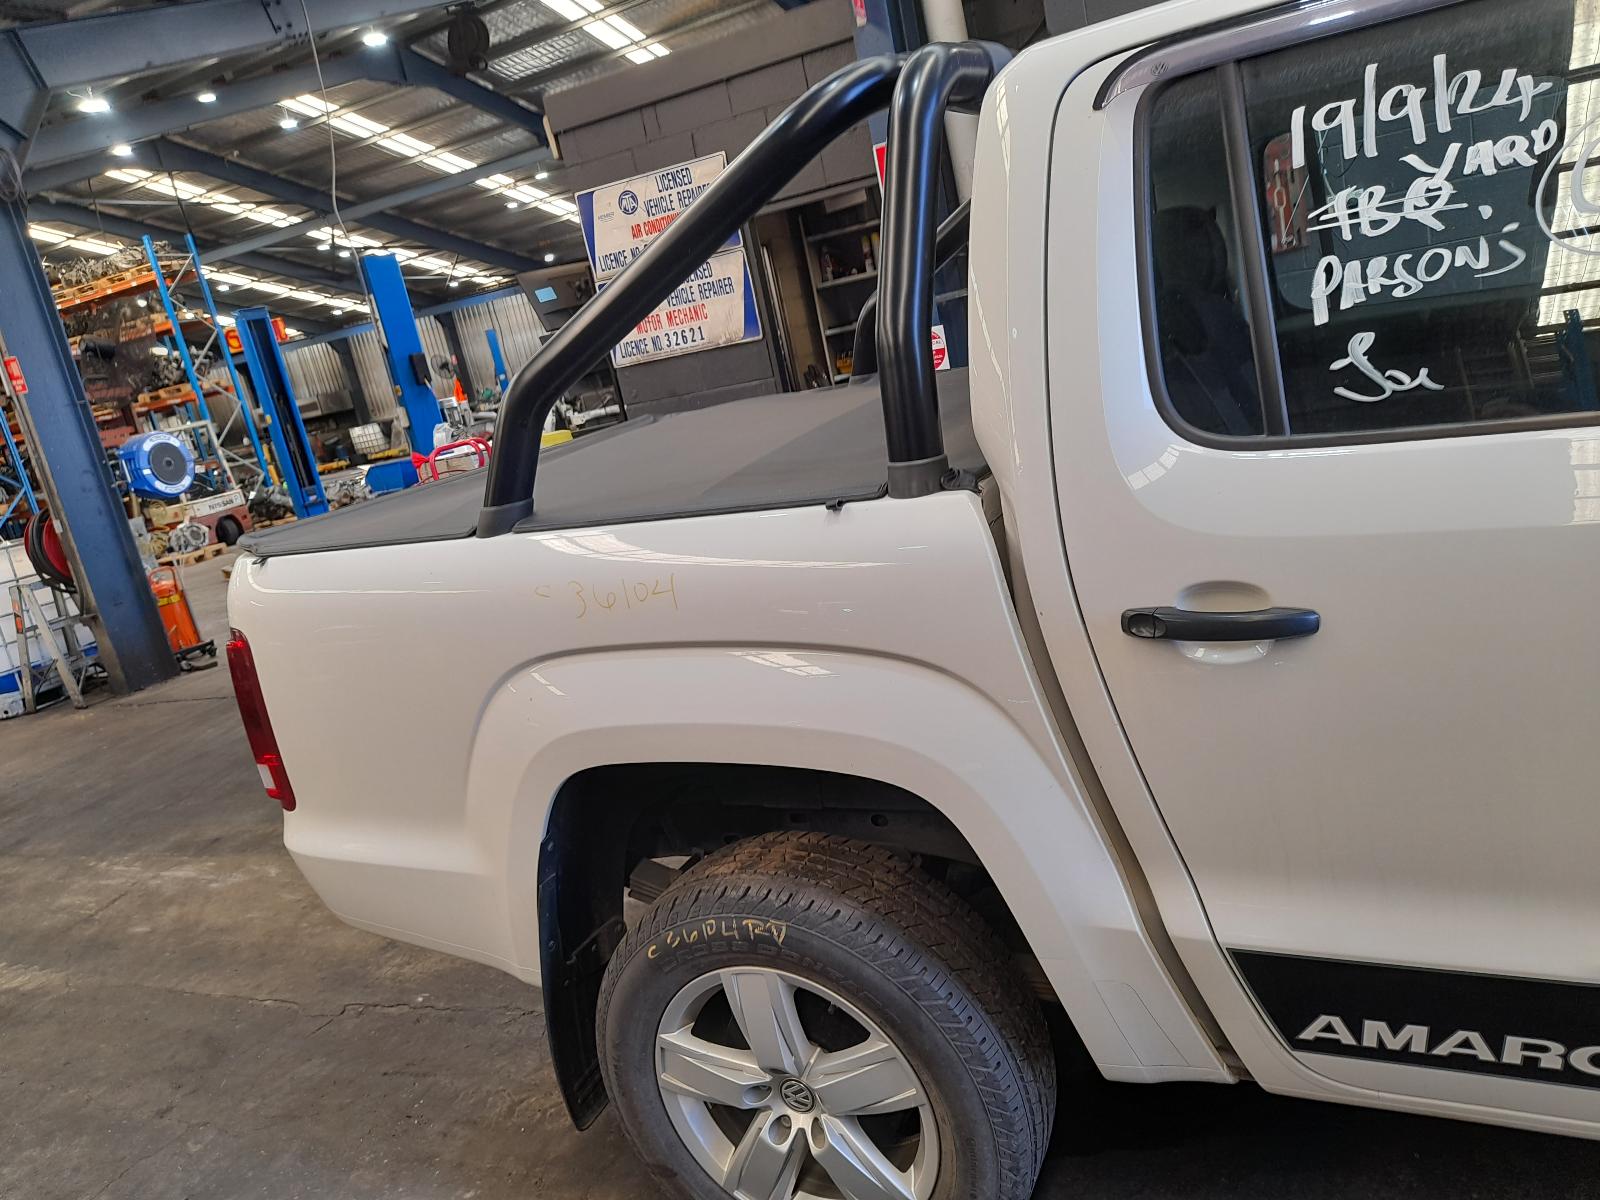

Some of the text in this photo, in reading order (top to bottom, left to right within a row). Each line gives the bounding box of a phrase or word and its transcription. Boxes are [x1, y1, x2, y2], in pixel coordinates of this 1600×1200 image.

[1291, 54, 1553, 169] 19/9/24
[1399, 119, 1558, 189] YARD
[655, 167, 692, 193] LICENSED
[644, 193, 675, 217] VEHICLE
[631, 223, 644, 240] AIR
[598, 249, 628, 272] LICENCE
[666, 277, 735, 307] VEHICLE REPAIRER
[636, 303, 708, 335] MOTOR MECHANIC
[619, 338, 650, 358] LICENCE
[651, 335, 665, 352] NO.
[665, 325, 705, 348] 32621
